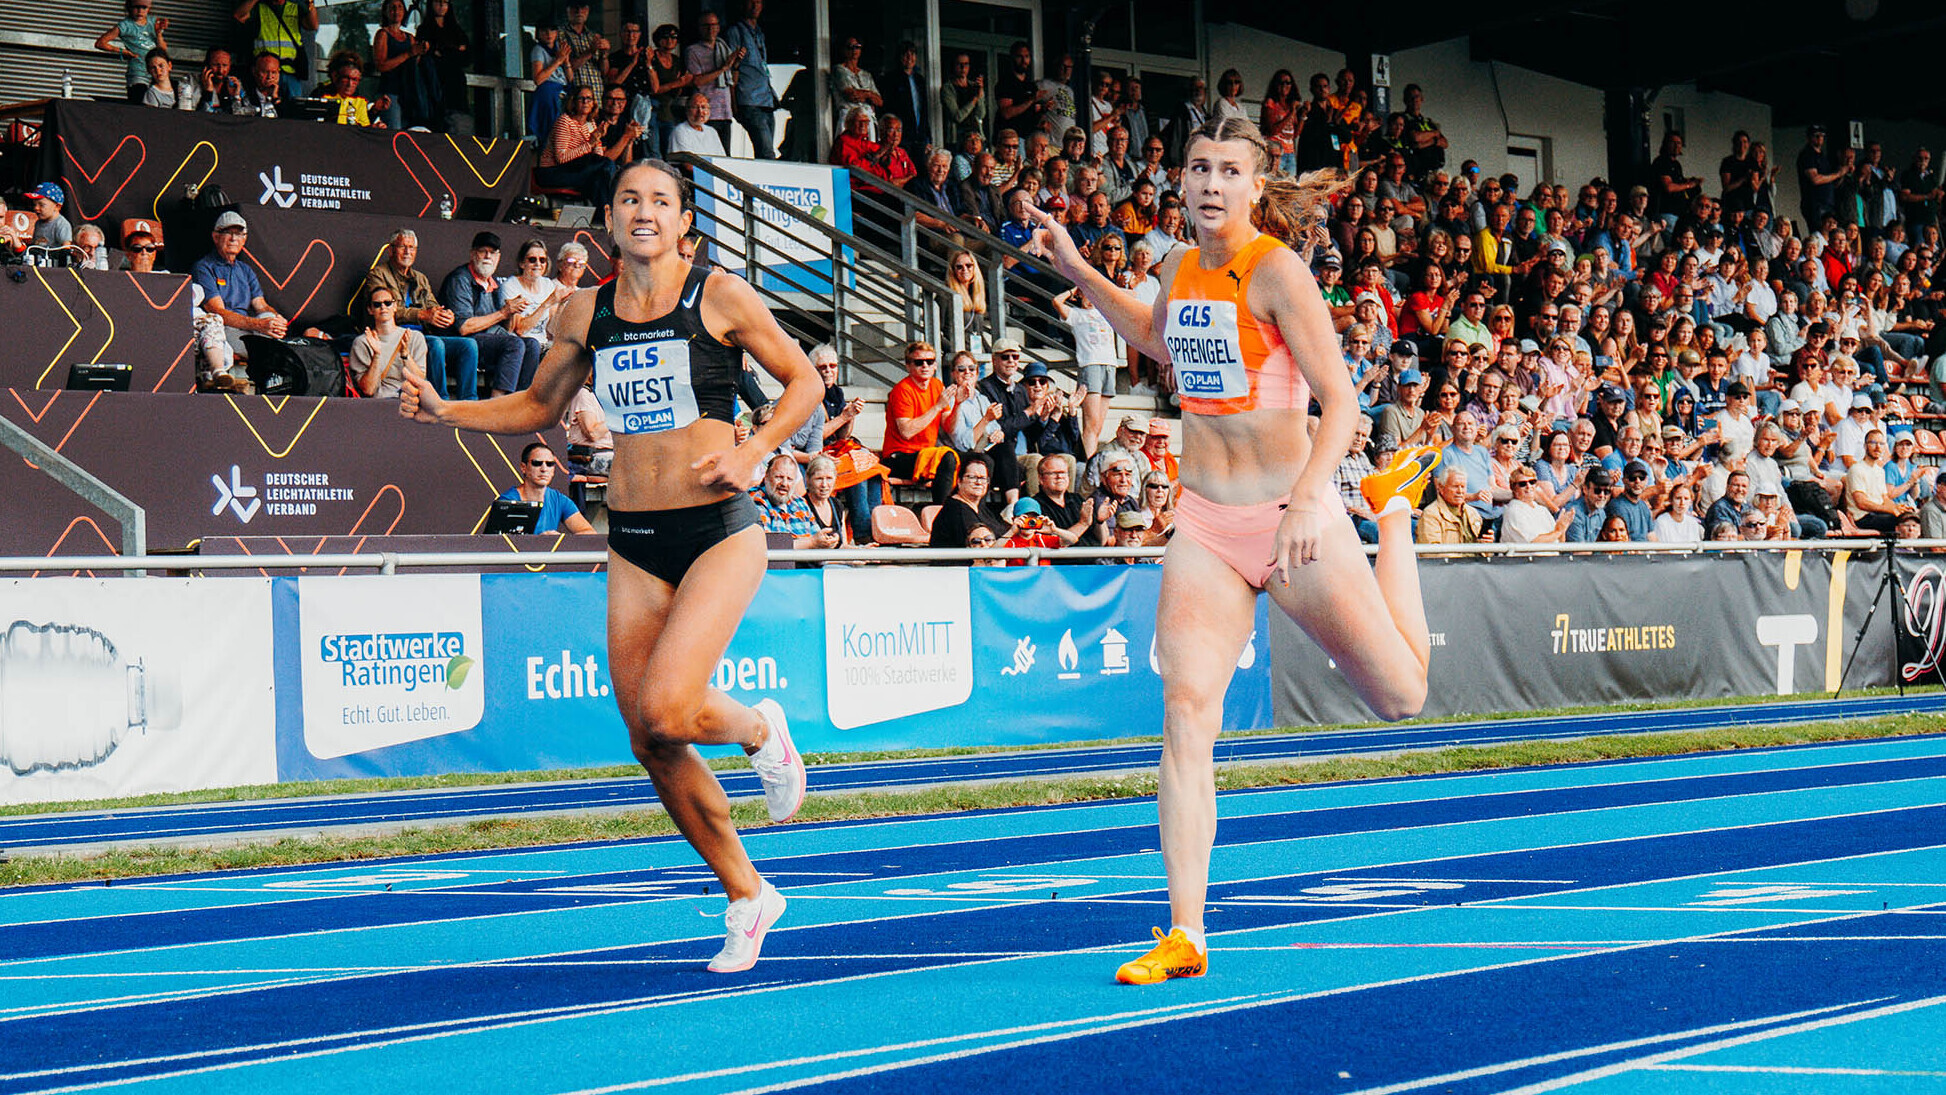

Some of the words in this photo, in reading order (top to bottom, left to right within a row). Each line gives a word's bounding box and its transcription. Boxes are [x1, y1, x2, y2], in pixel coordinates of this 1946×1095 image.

[301, 174, 350, 187] DEUTSCHER
[301, 186, 371, 200] LEICHTATHLETIK
[301, 198, 341, 209] VERBAND
[623, 332, 638, 341] btc
[640, 329, 675, 340] markets
[1167, 336, 1237, 364] SPRENGEL
[1196, 374, 1220, 386] PLAN
[608, 376, 675, 408] WEST
[643, 411, 672, 426] PLAN
[266, 473, 329, 486] DEUTSCHER
[266, 488, 354, 501] LEICHTATHLETIK
[266, 503, 317, 516] VERBAND
[325, 633, 461, 661] Stadtwerke
[843, 621, 954, 658] KomMITT
[1570, 625, 1676, 653] TRUEATHLETES
[342, 659, 446, 692] Ratingen
[526, 650, 609, 700] Echt.
[709, 655, 789, 692] ben.
[845, 666, 880, 686] 100%
[884, 661, 957, 685] Stadtwerke
[342, 704, 375, 725] Echt.
[377, 705, 404, 723] Gut.
[406, 702, 451, 722] Leben.
